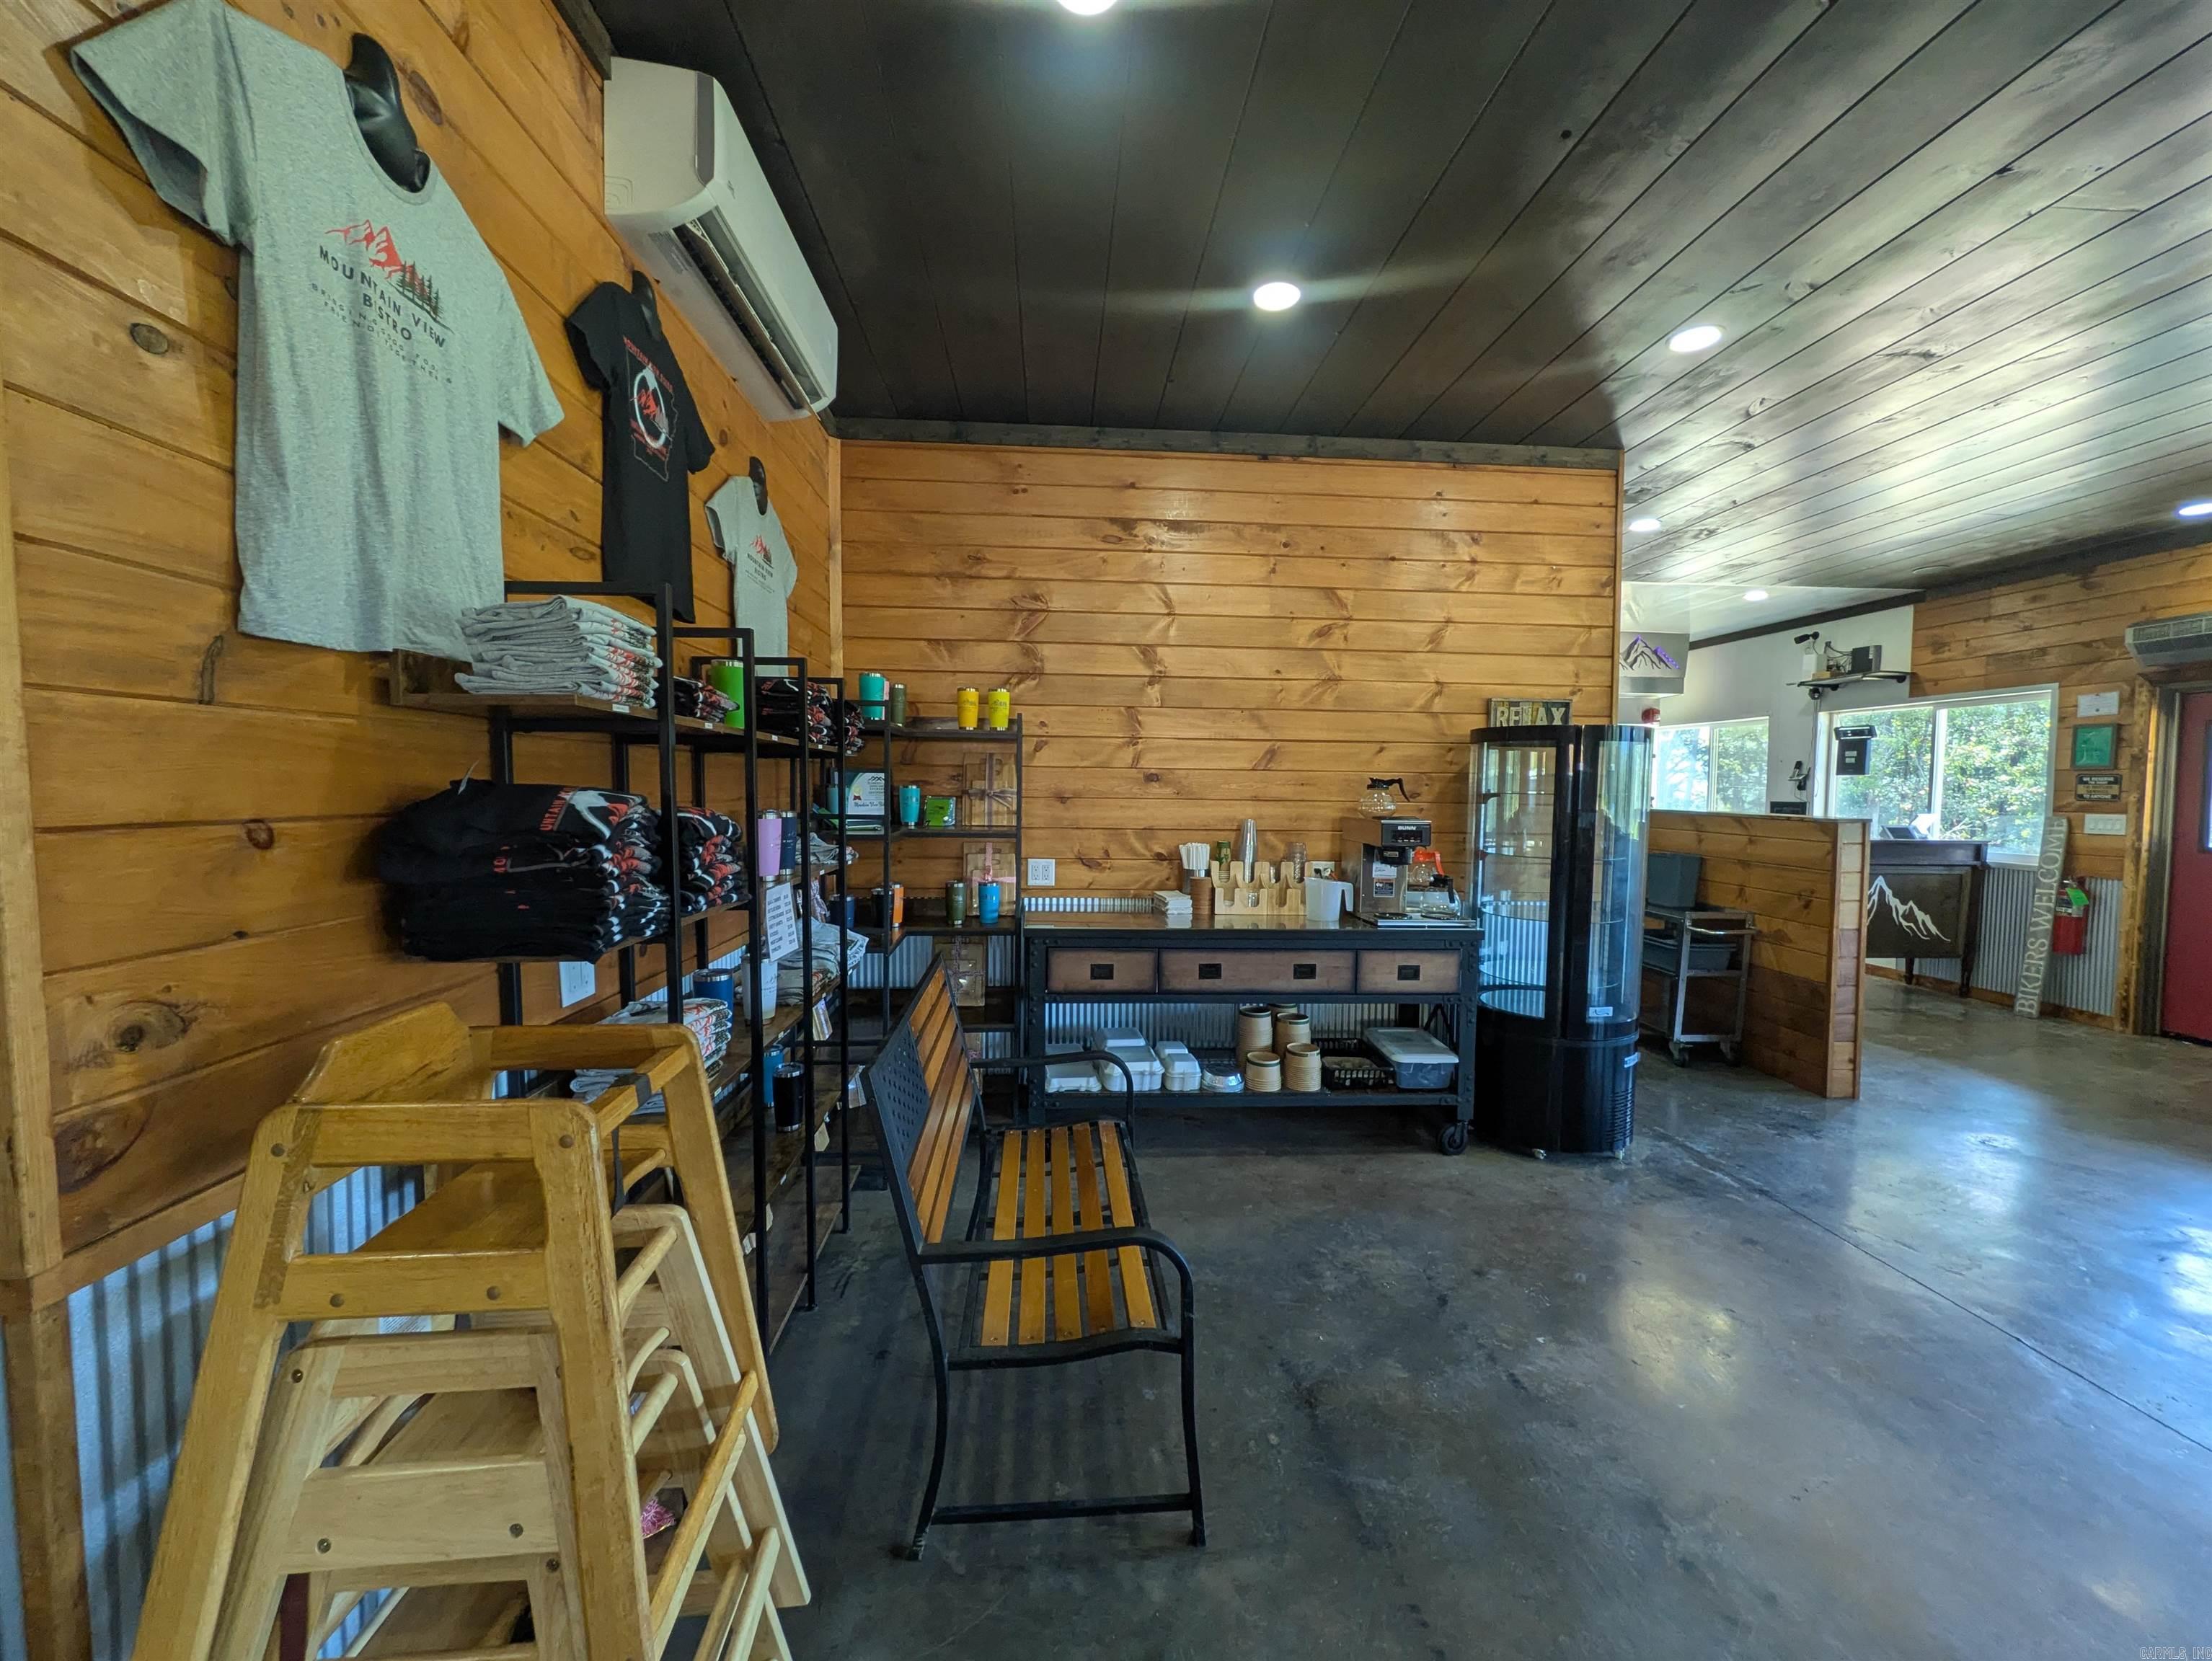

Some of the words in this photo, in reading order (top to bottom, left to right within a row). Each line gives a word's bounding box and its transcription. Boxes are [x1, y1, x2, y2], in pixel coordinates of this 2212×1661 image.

[319, 244, 401, 316] MOUNTAIN
[412, 312, 446, 347] VIEW
[363, 293, 412, 340] BISTRO
[1496, 707, 1566, 727] RELAX
[2030, 817, 2068, 932] WELCOME
[2017, 938, 2049, 1016] BIKERS
